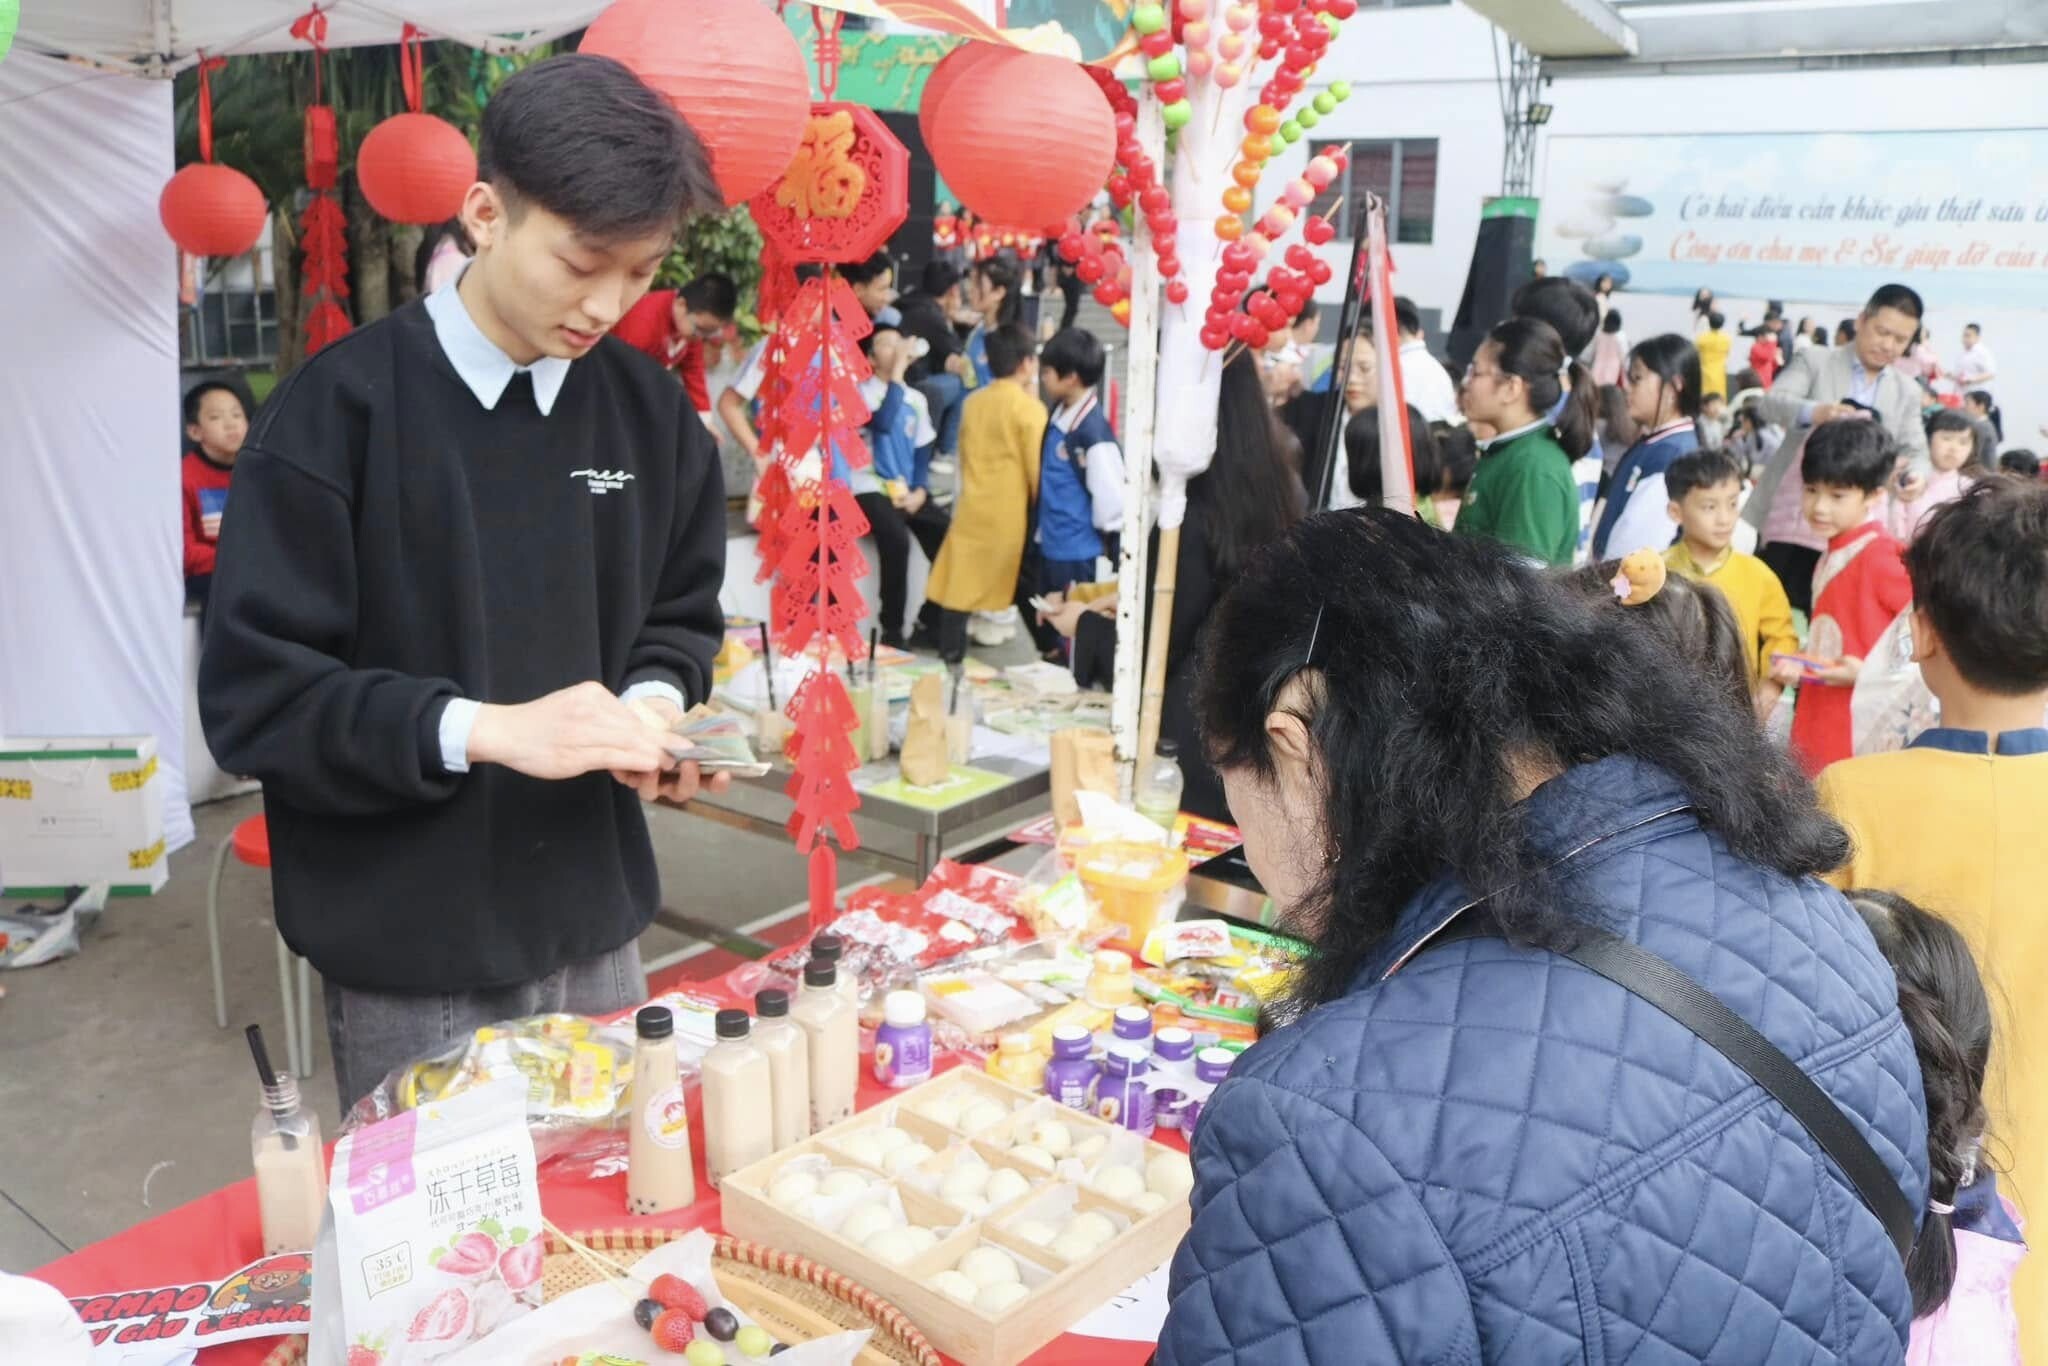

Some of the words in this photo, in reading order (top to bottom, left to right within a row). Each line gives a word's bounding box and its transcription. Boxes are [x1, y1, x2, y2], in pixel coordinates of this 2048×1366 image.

[1716, 193, 1747, 219] hai
[425, 1154, 521, 1218] 冻干草莓
